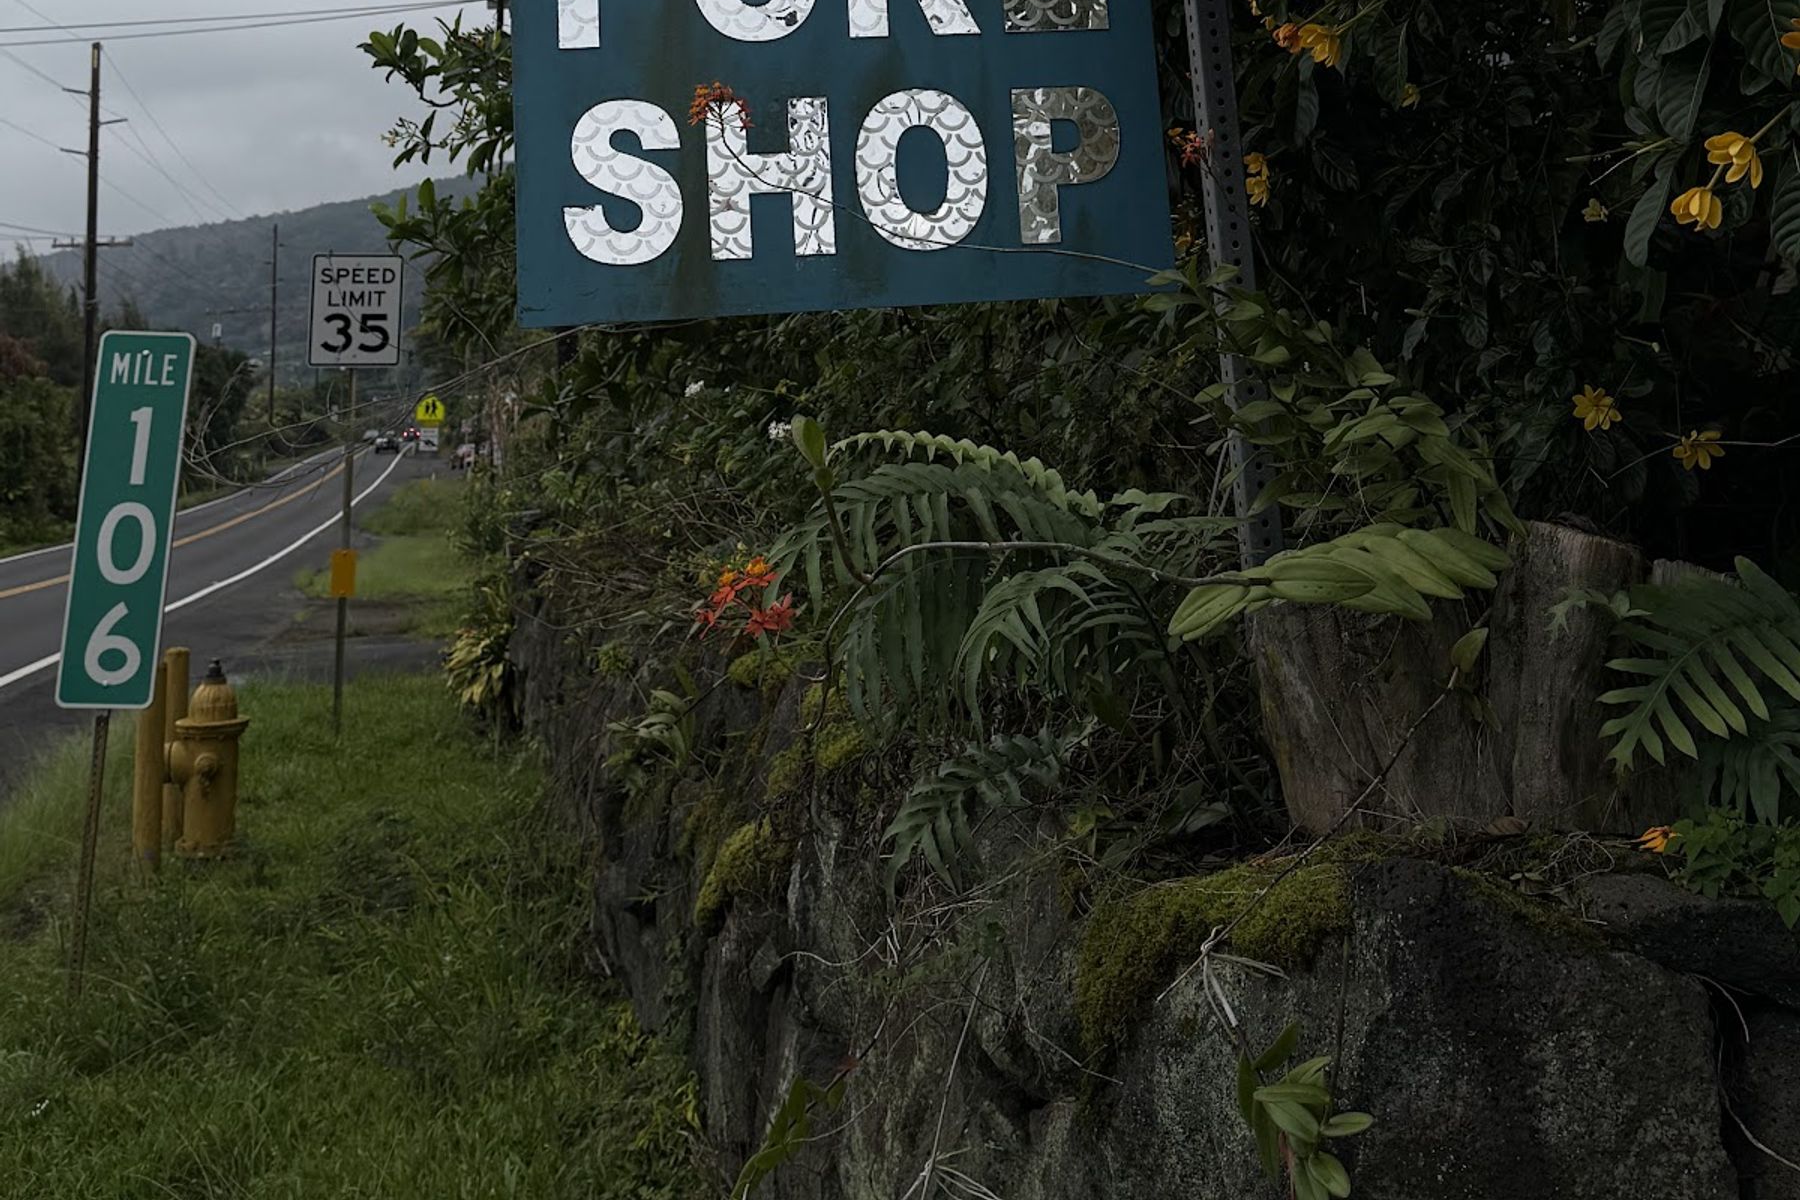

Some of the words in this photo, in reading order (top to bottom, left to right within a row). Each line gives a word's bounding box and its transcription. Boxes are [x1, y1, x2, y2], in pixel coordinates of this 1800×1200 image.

[562, 87, 1120, 265] SHOP
[320, 267, 396, 284] SPEED
[327, 290, 387, 307] LIMIT
[320, 312, 390, 353] 35
[110, 351, 178, 387] MILE
[84, 405, 157, 686] 106
